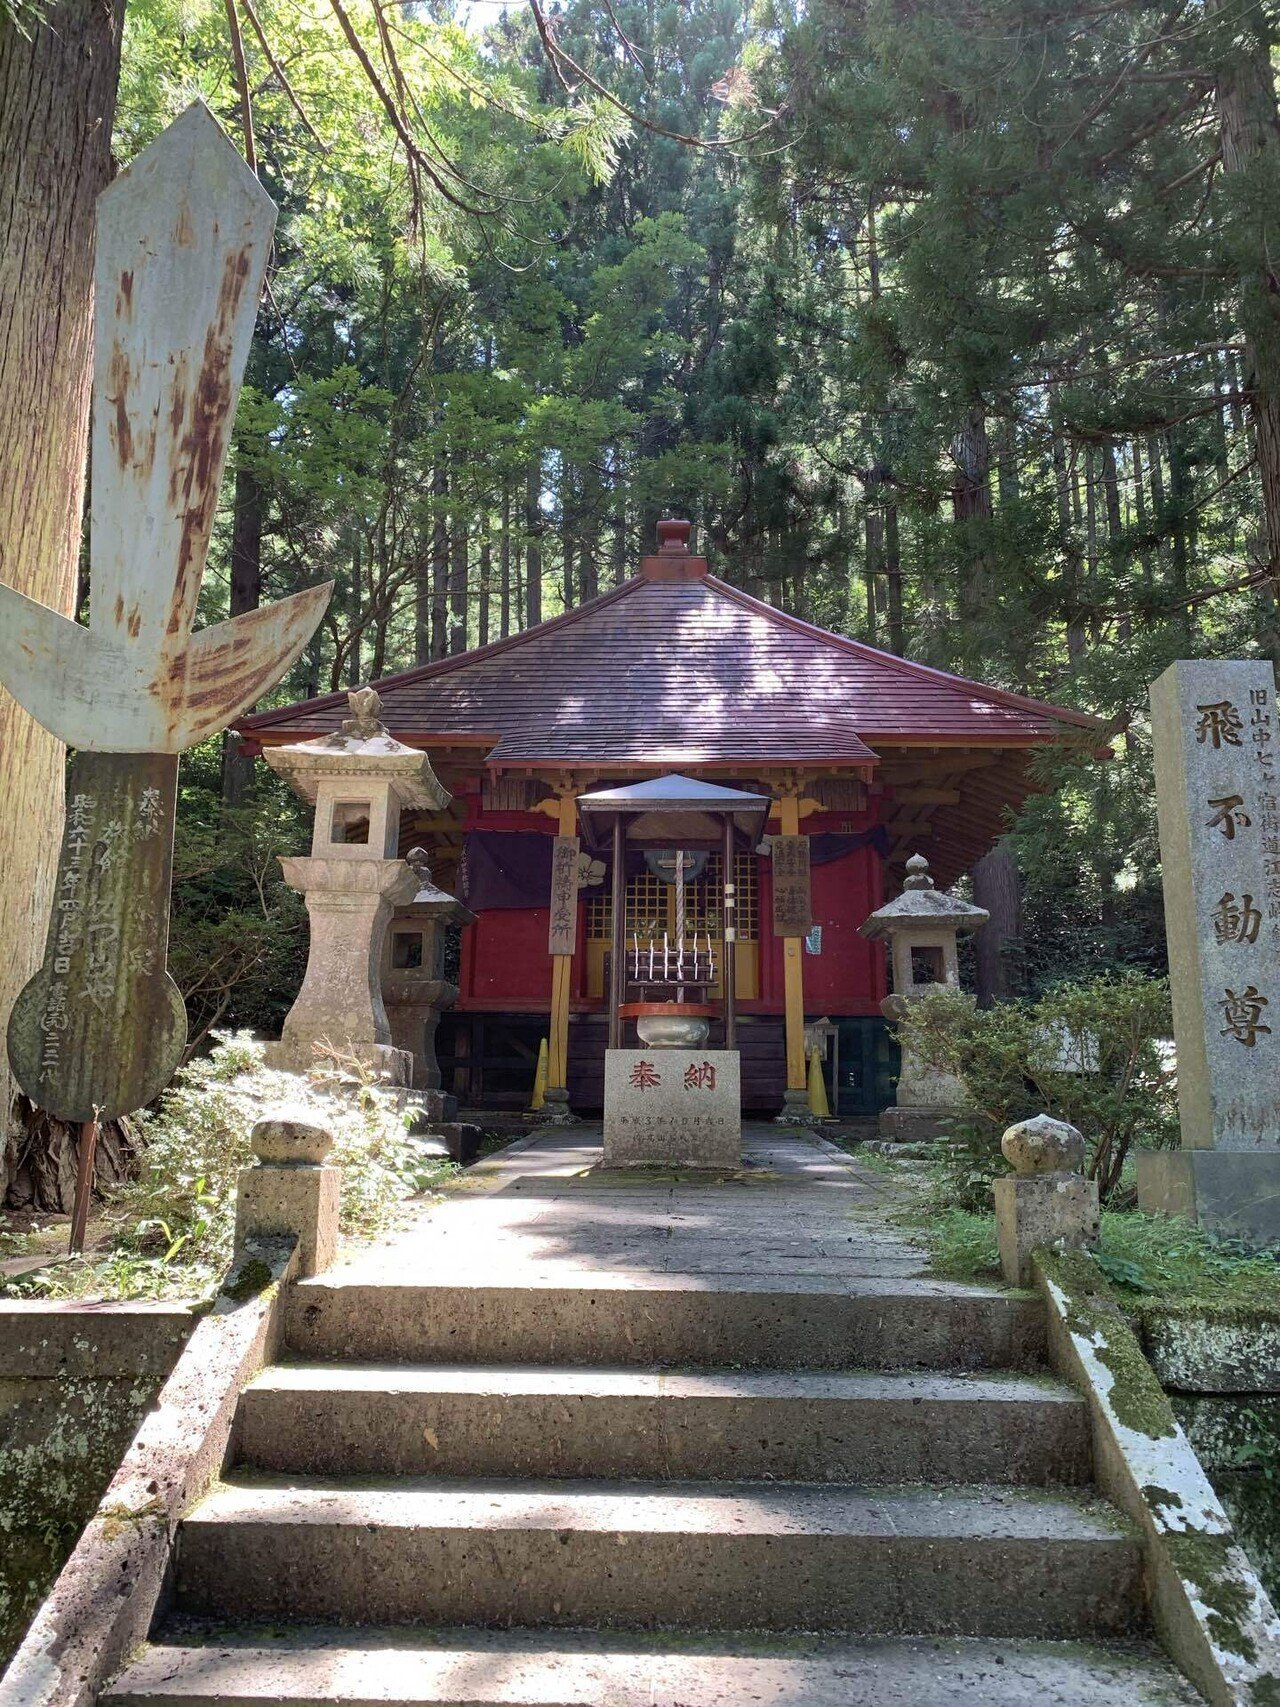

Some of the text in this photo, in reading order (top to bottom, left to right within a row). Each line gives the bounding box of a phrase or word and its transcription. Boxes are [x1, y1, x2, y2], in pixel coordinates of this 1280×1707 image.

[1195, 700, 1272, 1048] 飛不動尊
[628, 1060, 717, 1093] 奉納
